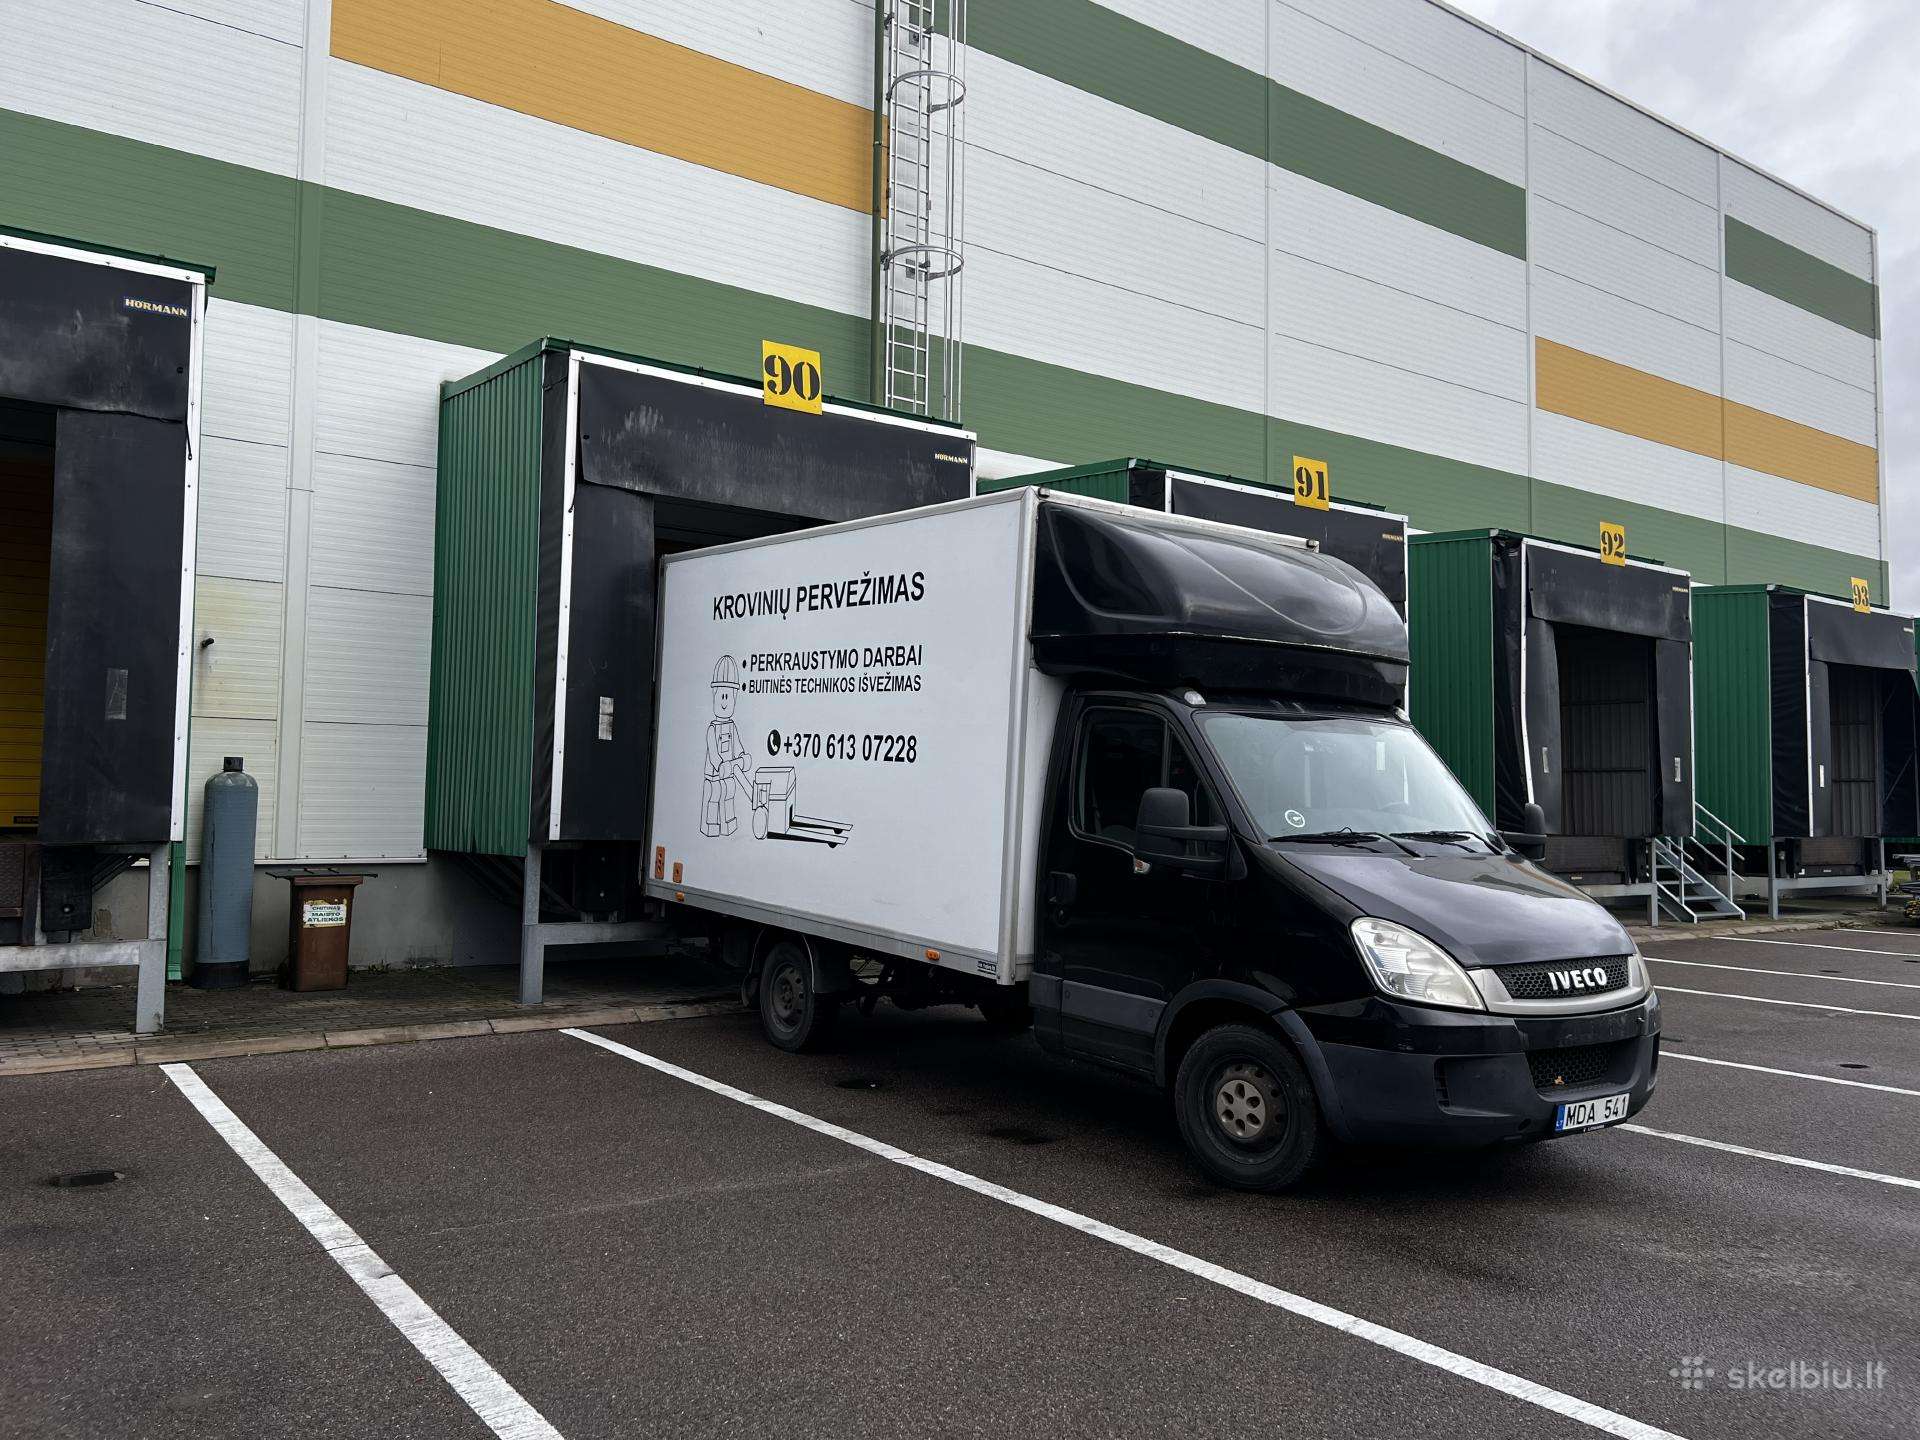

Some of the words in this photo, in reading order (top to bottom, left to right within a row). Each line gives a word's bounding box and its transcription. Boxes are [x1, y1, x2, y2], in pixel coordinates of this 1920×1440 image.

[765, 354, 820, 401] 90
[1296, 466, 1326, 500] 91
[1601, 530, 1624, 558] 92
[713, 588, 790, 620] KROVINIŲ
[796, 571, 925, 612] PERVEŽIMAS
[1853, 584, 1868, 606] 93
[750, 649, 859, 671] PERKRAUSTYMO
[863, 645, 922, 668] DARBAI
[749, 675, 792, 693] BUITINĖS
[795, 677, 855, 693] TECHNIKOS
[858, 672, 921, 692] IŠVEŽIMAS
[784, 733, 821, 758] +370
[826, 734, 856, 760] 613
[862, 734, 917, 763] 07228
[1548, 967, 1607, 991] IVECO
[1566, 1102, 1595, 1126] MDA
[1604, 1096, 1627, 1118] 541
